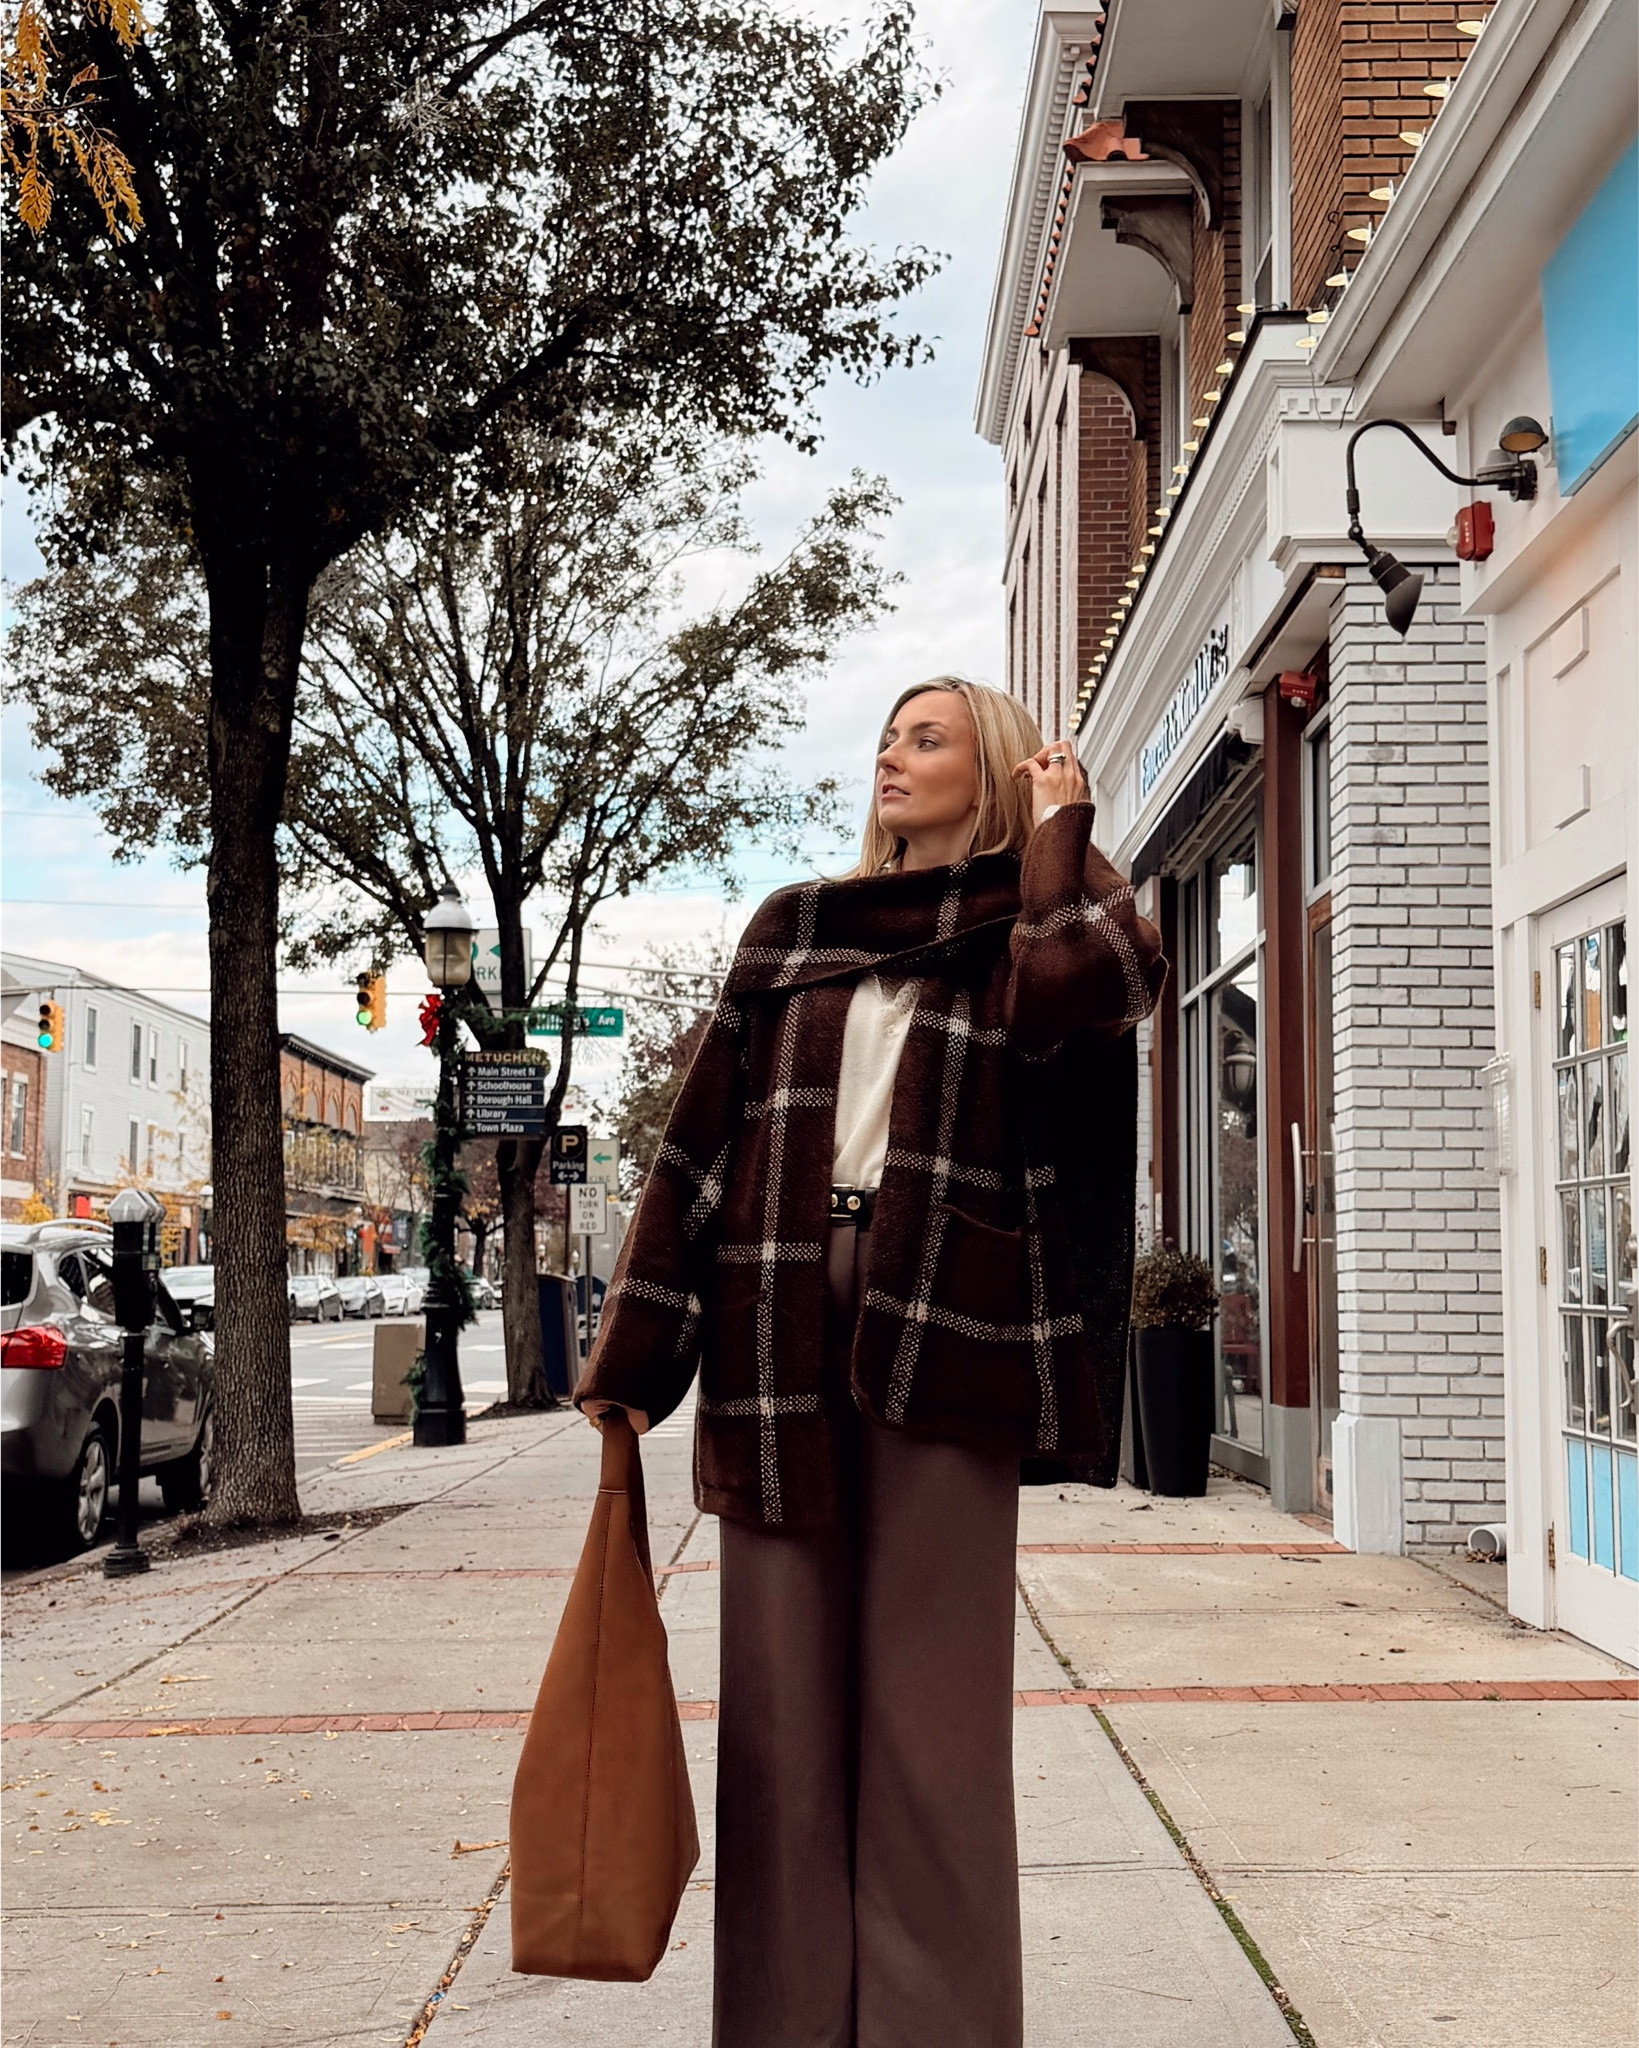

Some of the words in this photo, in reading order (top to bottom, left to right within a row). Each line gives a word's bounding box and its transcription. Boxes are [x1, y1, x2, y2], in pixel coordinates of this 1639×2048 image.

[598, 1014, 616, 1026] Ave
[465, 1052, 541, 1063] METUCHEN
[477, 1066, 499, 1077] Main
[501, 1066, 527, 1077] Street
[528, 1067, 536, 1077] N
[477, 1081, 533, 1091] Schoolhouse
[477, 1095, 514, 1107] Borough
[515, 1095, 533, 1105] Hall
[476, 1109, 507, 1120] Library
[476, 1123, 499, 1133] Town
[501, 1123, 525, 1133] Plaza
[562, 1135, 579, 1153] P
[552, 1161, 585, 1172] Parking
[579, 1187, 597, 1198] NO
[579, 1200, 599, 1209] TURN
[582, 1211, 595, 1220] ON
[580, 1221, 597, 1230] RED
